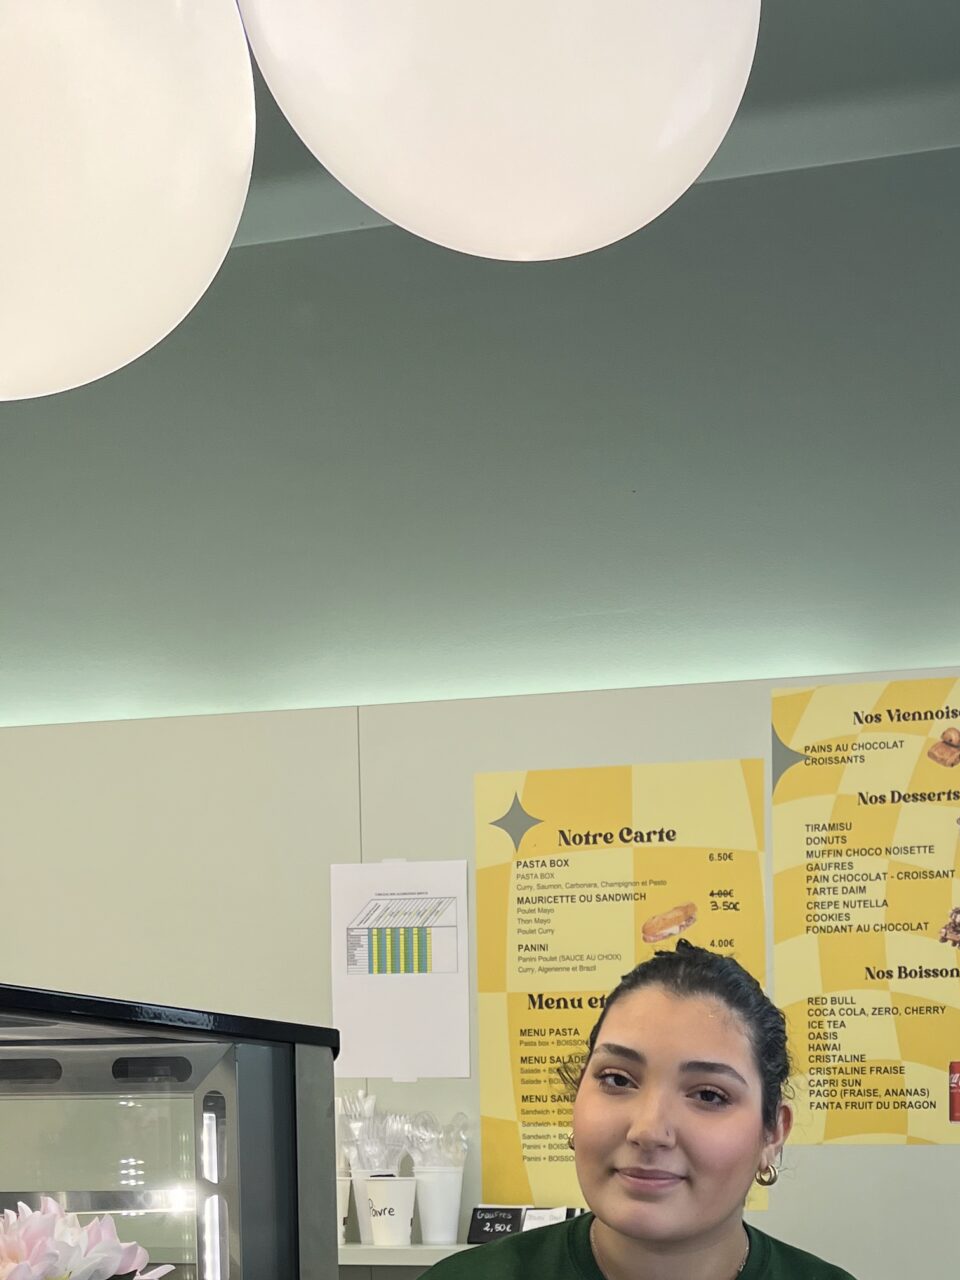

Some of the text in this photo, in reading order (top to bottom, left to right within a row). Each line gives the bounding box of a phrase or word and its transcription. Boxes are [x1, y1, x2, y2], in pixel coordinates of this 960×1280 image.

[853, 710, 882, 725] Nos
[805, 740, 904, 753] PAINS AU CHOCOLAT
[805, 755, 865, 766] CROISSANTS
[858, 789, 960, 806] Nos Desserts
[805, 822, 852, 833] TIRAMISU
[558, 826, 676, 847] Notre Carte
[806, 836, 847, 846] DONUTS
[709, 852, 734, 862] 6.50€
[806, 845, 935, 859] MUFFIN CHOCO NOISETTE
[516, 859, 570, 869] PASTA BOX
[806, 862, 853, 872] GAUFRES
[516, 872, 538, 880] PASTA
[806, 870, 955, 884] PAIN CHOCOLAT CROISSANT
[807, 885, 866, 896] TARTE DAIM
[517, 892, 646, 905] MAURICETTE OU SANDWICH
[807, 899, 888, 910] CREPE NUTELLA
[537, 907, 554, 916] Mayo
[535, 917, 551, 926] Mayo
[806, 912, 850, 922] COOKIES
[537, 928, 554, 936] Curry
[806, 922, 929, 934] FONDANT AU CHOCOLAT
[518, 944, 548, 952] PANINI
[710, 939, 734, 948] 4.00€
[865, 967, 893, 980] Nos
[528, 994, 583, 1011] Menu
[808, 996, 856, 1006] RED BULL
[808, 1006, 946, 1017] COCA COLA, ZERO, CHERRY
[808, 1020, 846, 1030] ICE TEA
[520, 1027, 580, 1037] MENU PASTA
[809, 1032, 838, 1041] OASIS
[809, 1043, 841, 1052] HAWAI
[520, 1056, 547, 1065] MENU
[809, 1054, 866, 1064] CRISTALINE
[809, 1066, 905, 1076] CRISTALINE FRAISE
[809, 1078, 861, 1088] CAPRI SUN
[809, 1088, 930, 1099] PAGO (FRAISE, ANANAS)
[810, 1100, 936, 1110] FANTA FRUIT DU DRAGON
